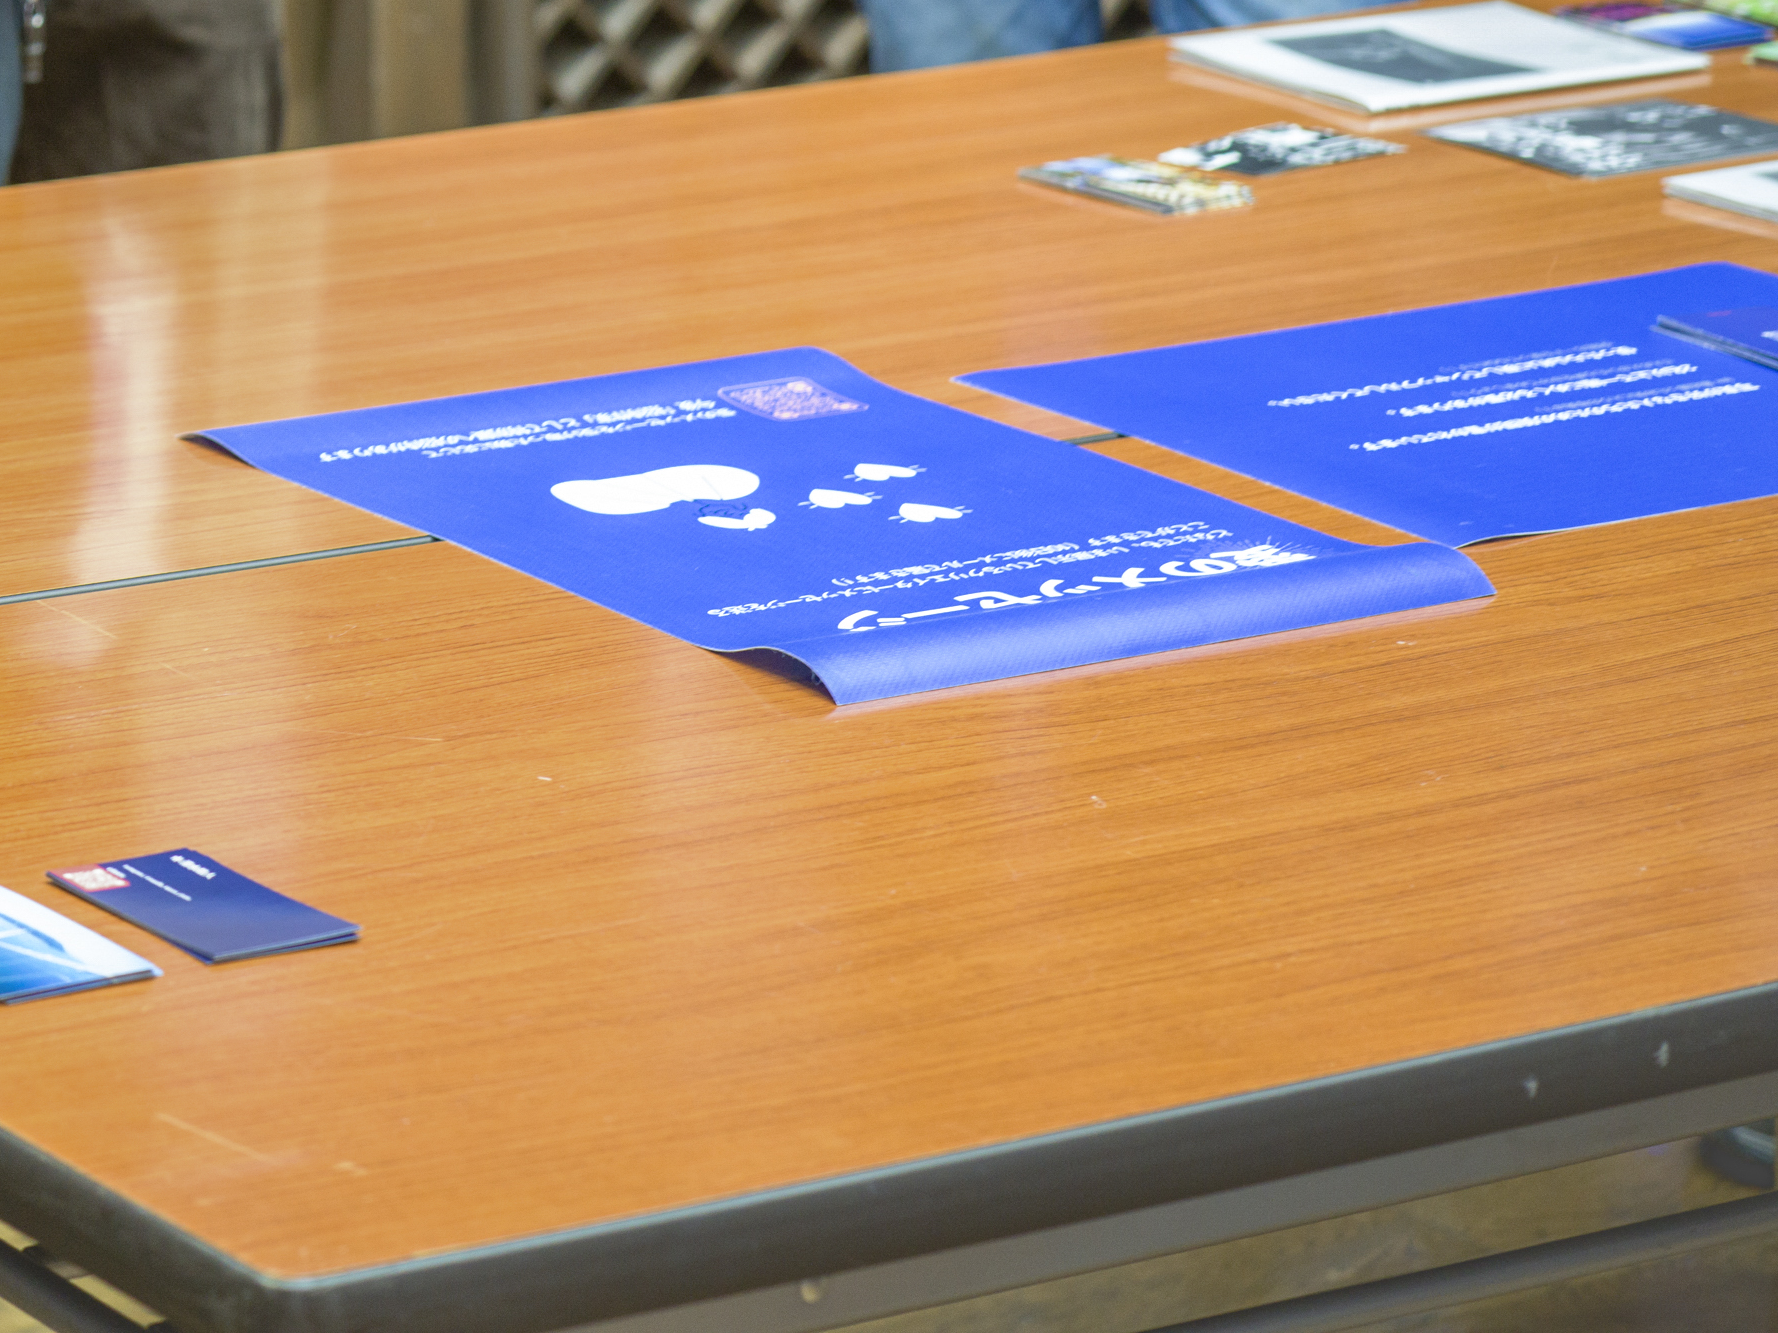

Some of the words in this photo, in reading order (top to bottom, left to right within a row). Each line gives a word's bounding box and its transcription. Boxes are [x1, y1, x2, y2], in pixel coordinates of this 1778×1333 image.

[708, 531, 1232, 617] どなたでも、いま展示しているクリエイターにメッセージを送る
[838, 545, 1316, 631] 愛のメッセージ
